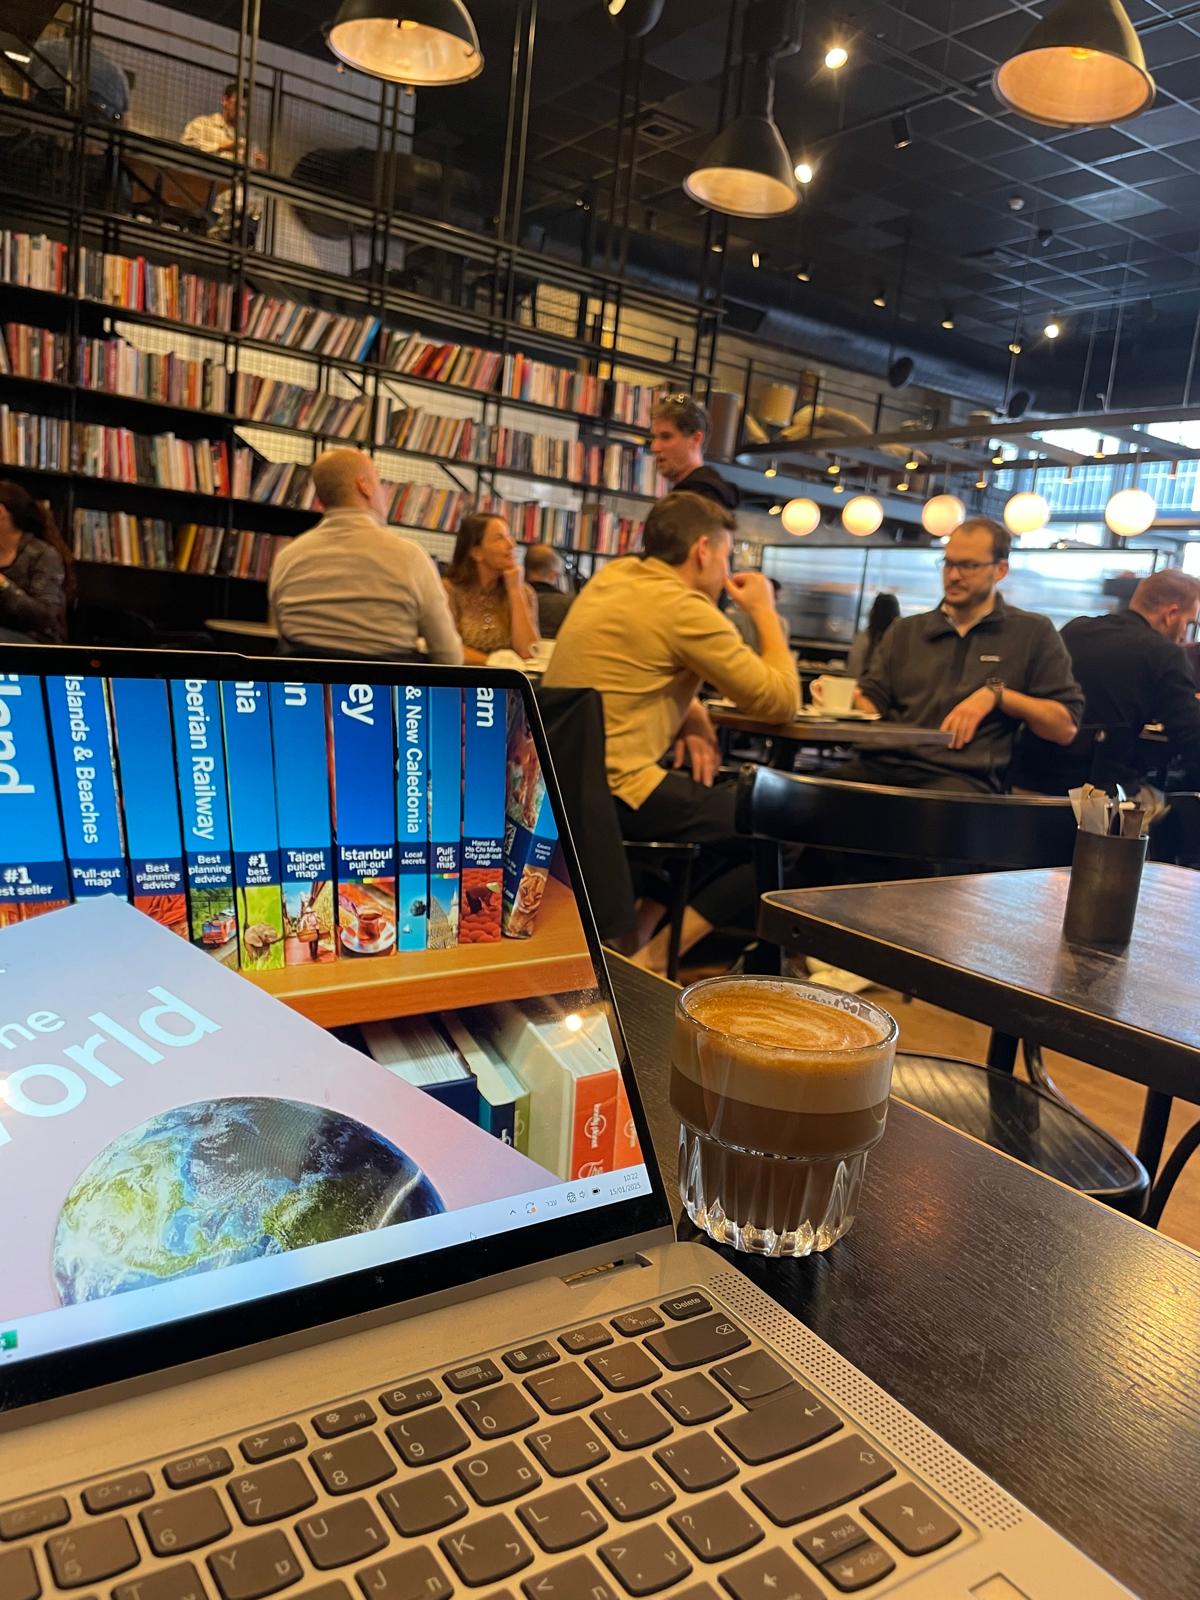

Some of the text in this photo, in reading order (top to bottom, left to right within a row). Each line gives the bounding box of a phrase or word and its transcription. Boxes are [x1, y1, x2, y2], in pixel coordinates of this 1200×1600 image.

[340, 684, 374, 726] ey
[73, 746, 93, 761] &
[405, 686, 423, 833] & New Caledonia
[192, 756, 216, 840] Railway
[76, 767, 100, 843] Beaches
[197, 855, 222, 864] Best
[248, 853, 268, 868] #1
[287, 851, 324, 864] Taipei
[464, 852, 478, 860] City
[145, 864, 170, 873] Best
[188, 865, 232, 876] planning
[287, 862, 326, 873] pull-out
[349, 860, 385, 871] pull-out
[436, 861, 456, 870] map
[3, 866, 32, 884] #1
[73, 868, 121, 879] Pull-out
[136, 873, 180, 883] planning
[247, 868, 269, 876] best
[295, 870, 318, 879] map
[357, 868, 379, 877] map
[84, 878, 113, 888] map
[142, 881, 177, 890] advice
[194, 875, 227, 884] advice
[246, 875, 272, 884] seller
[17, 884, 53, 896] seller
[673, 1297, 701, 1310] Delete
[536, 1351, 552, 1360] F12
[477, 1371, 493, 1379] F11
[415, 1390, 433, 1400] F10
[537, 1434, 552, 1451] P
[410, 1442, 425, 1457] 9
[332, 1470, 348, 1485] 8
[248, 1498, 262, 1514] 7
[529, 1507, 549, 1522] L
[307, 1518, 329, 1539] U
[160, 1528, 177, 1546] 6
[452, 1534, 474, 1555] K
[219, 1550, 237, 1570] Y
[374, 1569, 387, 1590] J
